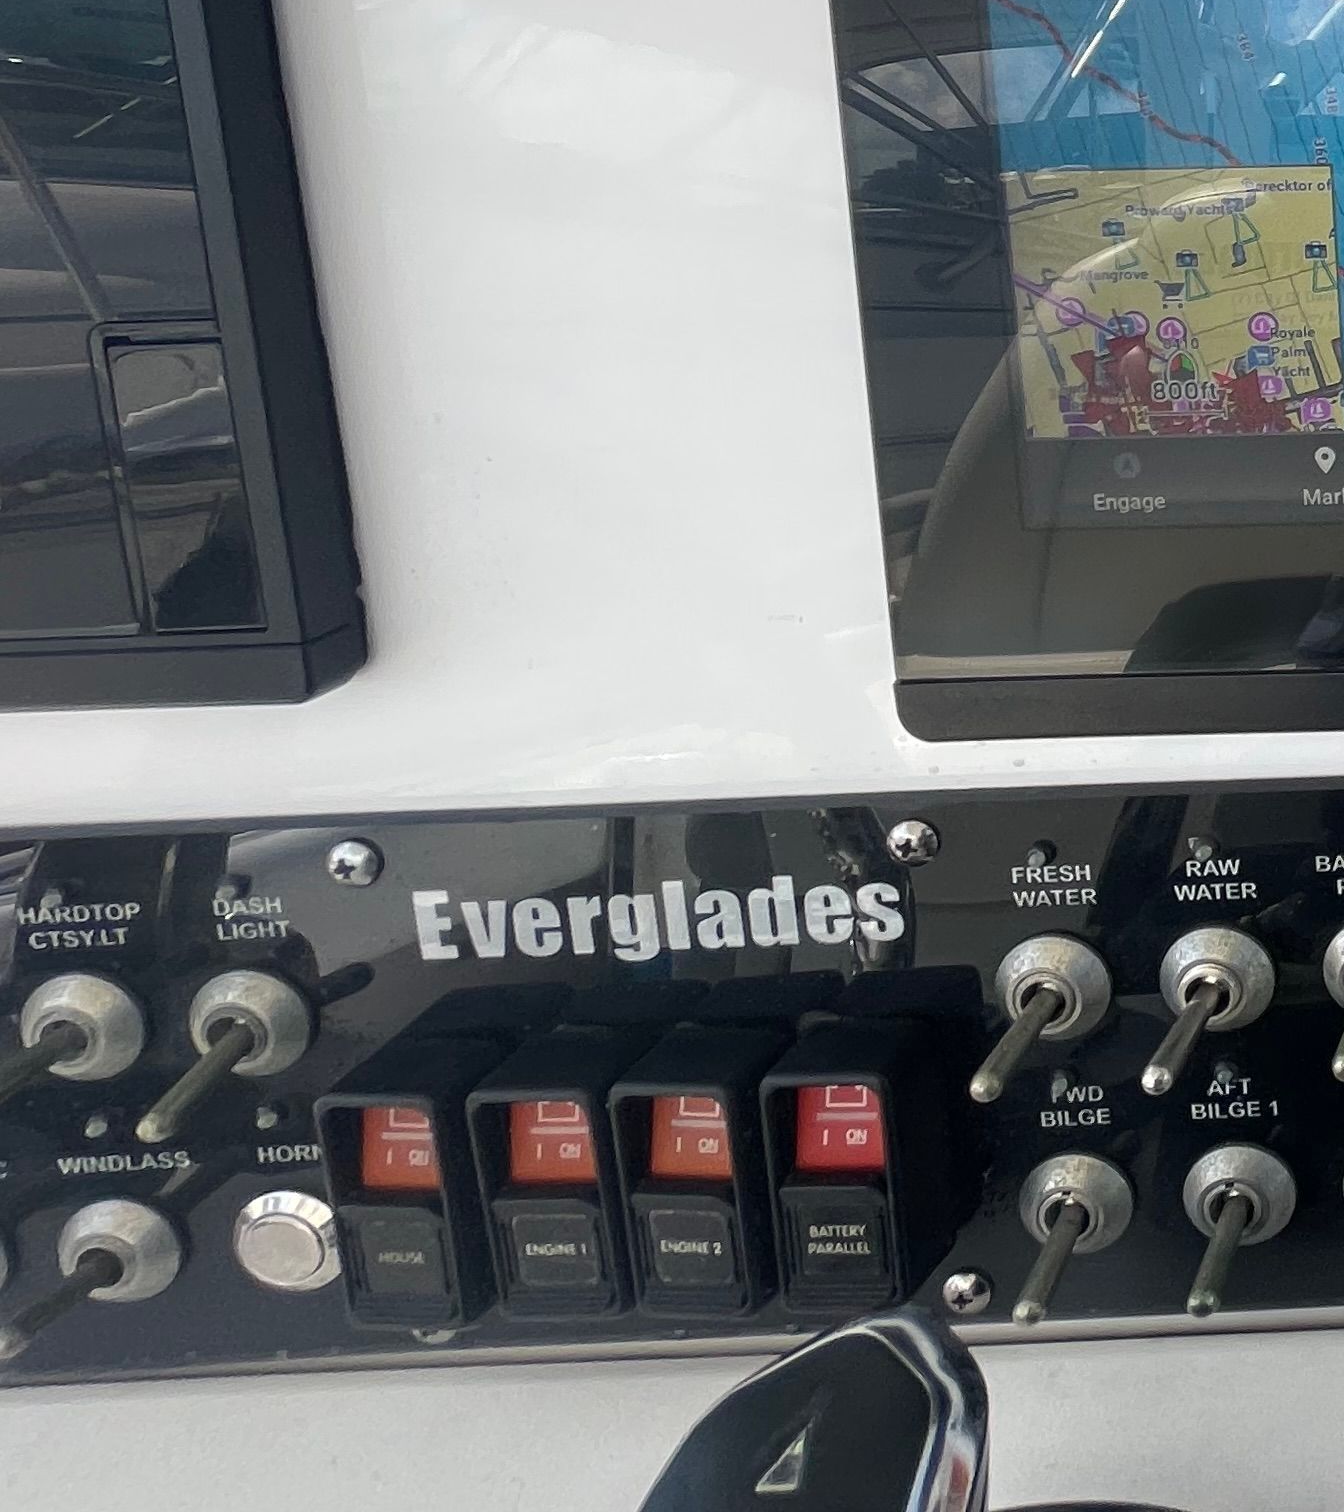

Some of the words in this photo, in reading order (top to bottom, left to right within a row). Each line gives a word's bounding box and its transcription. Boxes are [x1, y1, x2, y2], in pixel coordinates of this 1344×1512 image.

[1270, 327, 1316, 339] Royale
[1271, 347, 1306, 358] Palm
[1153, 382, 1219, 400] 800ft
[1092, 491, 1166, 515] Engage
[1010, 863, 1092, 885] FRESH
[1185, 858, 1241, 878] RAW
[1013, 887, 1098, 908] WATER
[1174, 881, 1258, 903] WATER
[17, 902, 142, 925] HARDTOP
[212, 895, 283, 917] DASH
[411, 874, 907, 962] Everglades
[216, 919, 291, 941] LIGHT
[1206, 1078, 1252, 1097] AFT
[1040, 1107, 1111, 1128] BILGE
[1190, 1100, 1262, 1120] BILGE
[1269, 1099, 1279, 1117] 1
[57, 1151, 192, 1176] WINDLASS
[809, 1224, 867, 1238] BATTERY
[525, 1243, 576, 1256] ENGINE
[580, 1243, 586, 1256] 1
[660, 1240, 710, 1254] ENGINE
[713, 1242, 722, 1255] 2
[808, 1241, 872, 1255] PARALLEL
